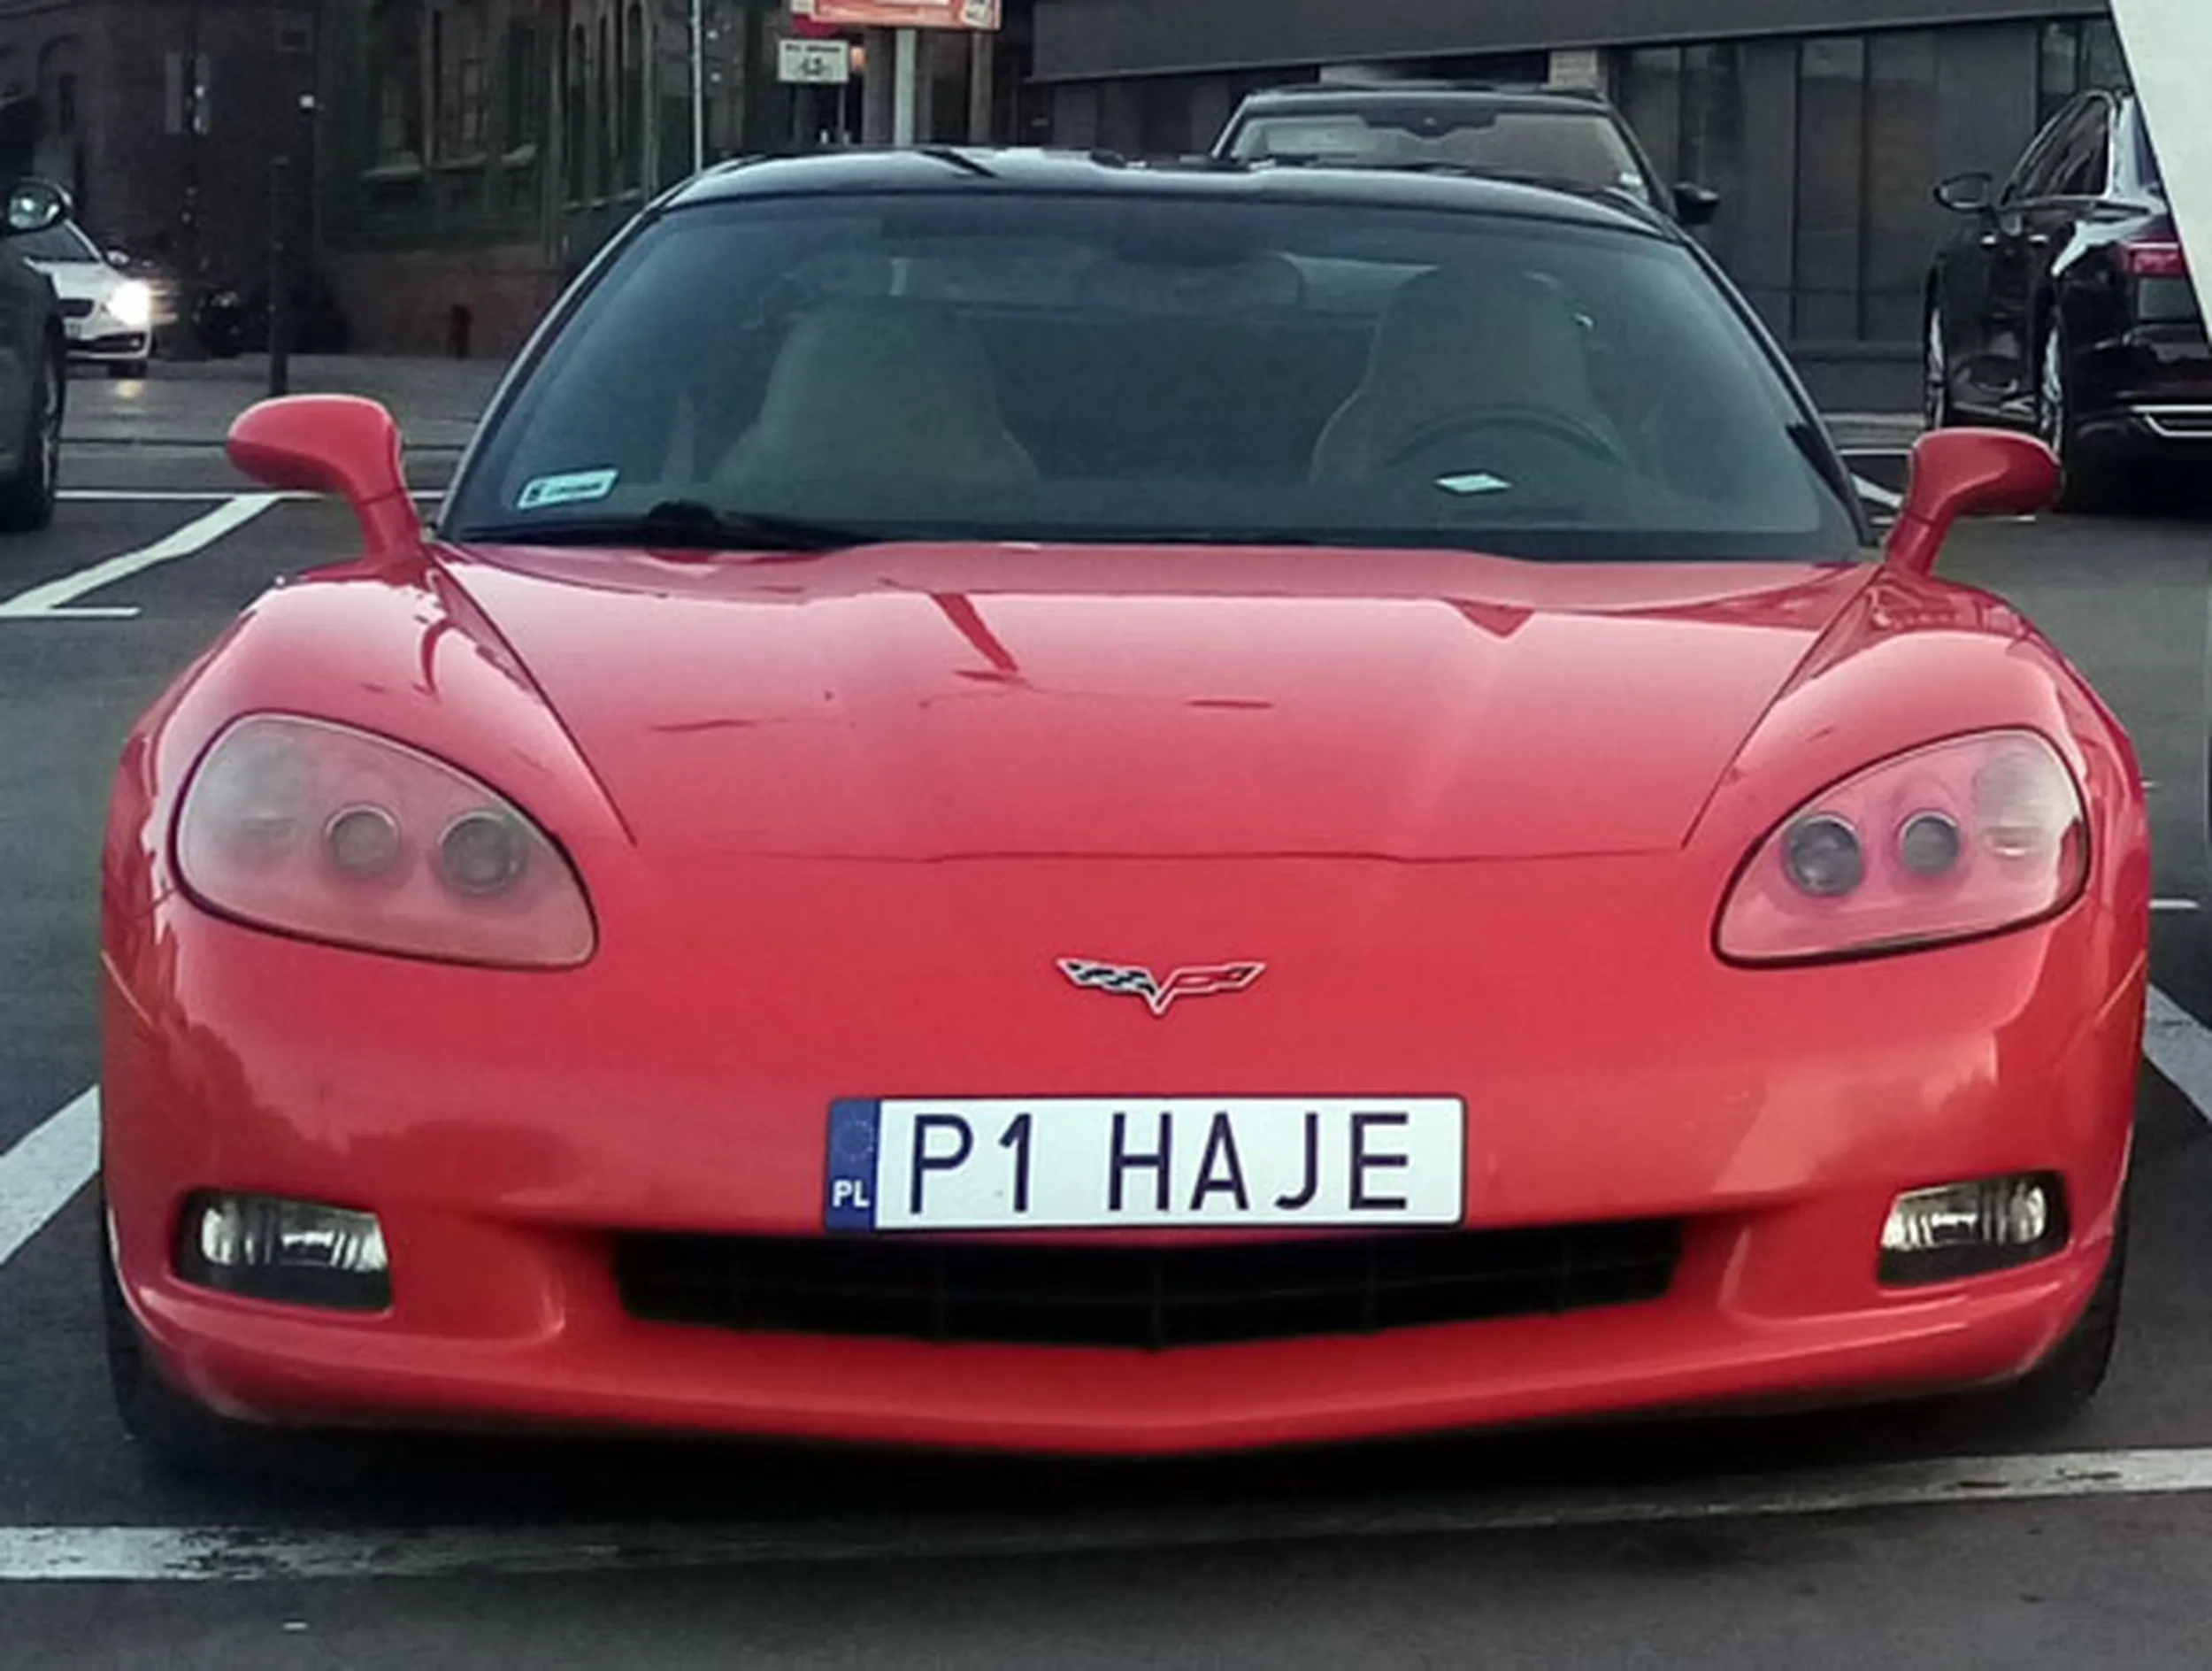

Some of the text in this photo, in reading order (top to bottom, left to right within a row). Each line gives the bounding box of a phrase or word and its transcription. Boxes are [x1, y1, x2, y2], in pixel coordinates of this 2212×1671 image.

[833, 1179, 871, 1207] PL
[910, 1112, 1409, 1214] P1 HAJE
